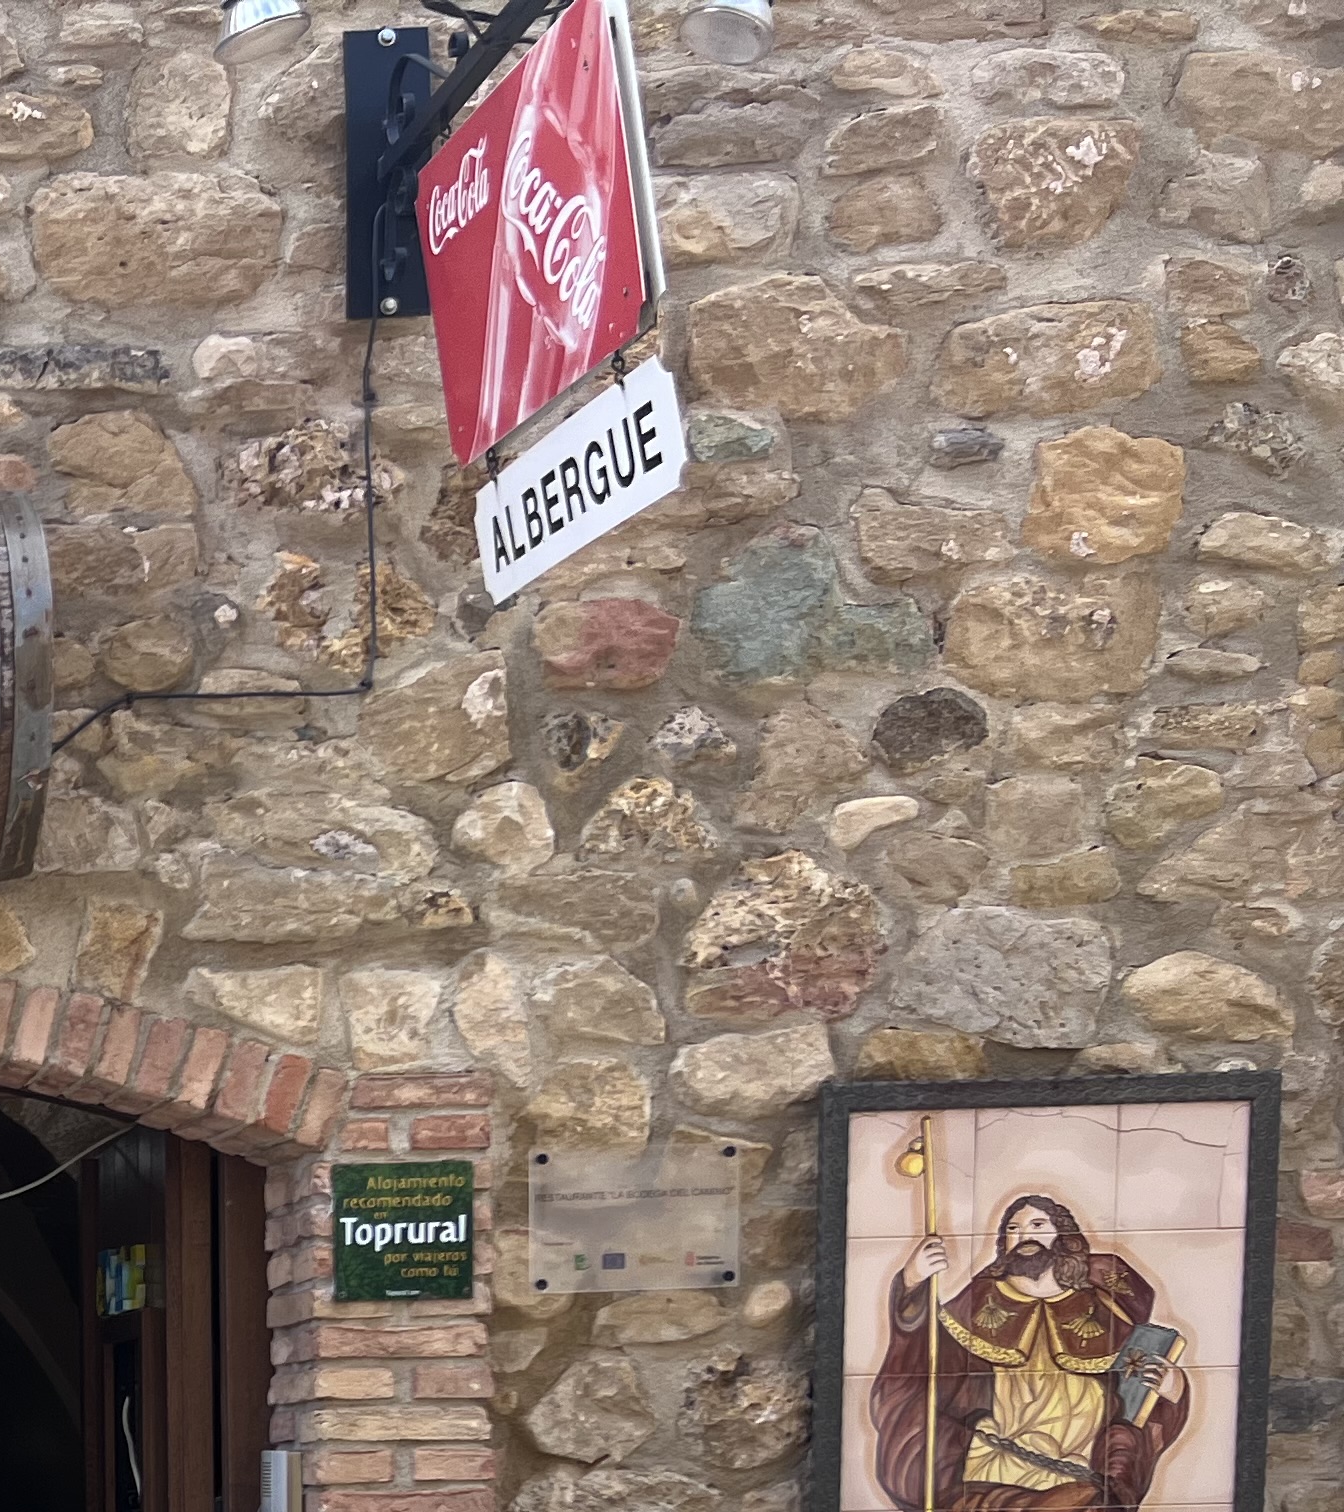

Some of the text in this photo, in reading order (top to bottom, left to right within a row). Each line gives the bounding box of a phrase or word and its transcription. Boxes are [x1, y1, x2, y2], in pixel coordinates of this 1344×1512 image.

[429, 133, 490, 255] Coca-Cola
[502, 131, 608, 330] Coca-Cola
[492, 401, 664, 573] ALBERGUE
[367, 1174, 465, 1192] Alojamiento
[343, 1193, 453, 1209] recomendado
[374, 1211, 388, 1219] en
[340, 1214, 467, 1252] Toprural
[384, 1251, 467, 1265] por viajeros
[401, 1267, 439, 1278] como
